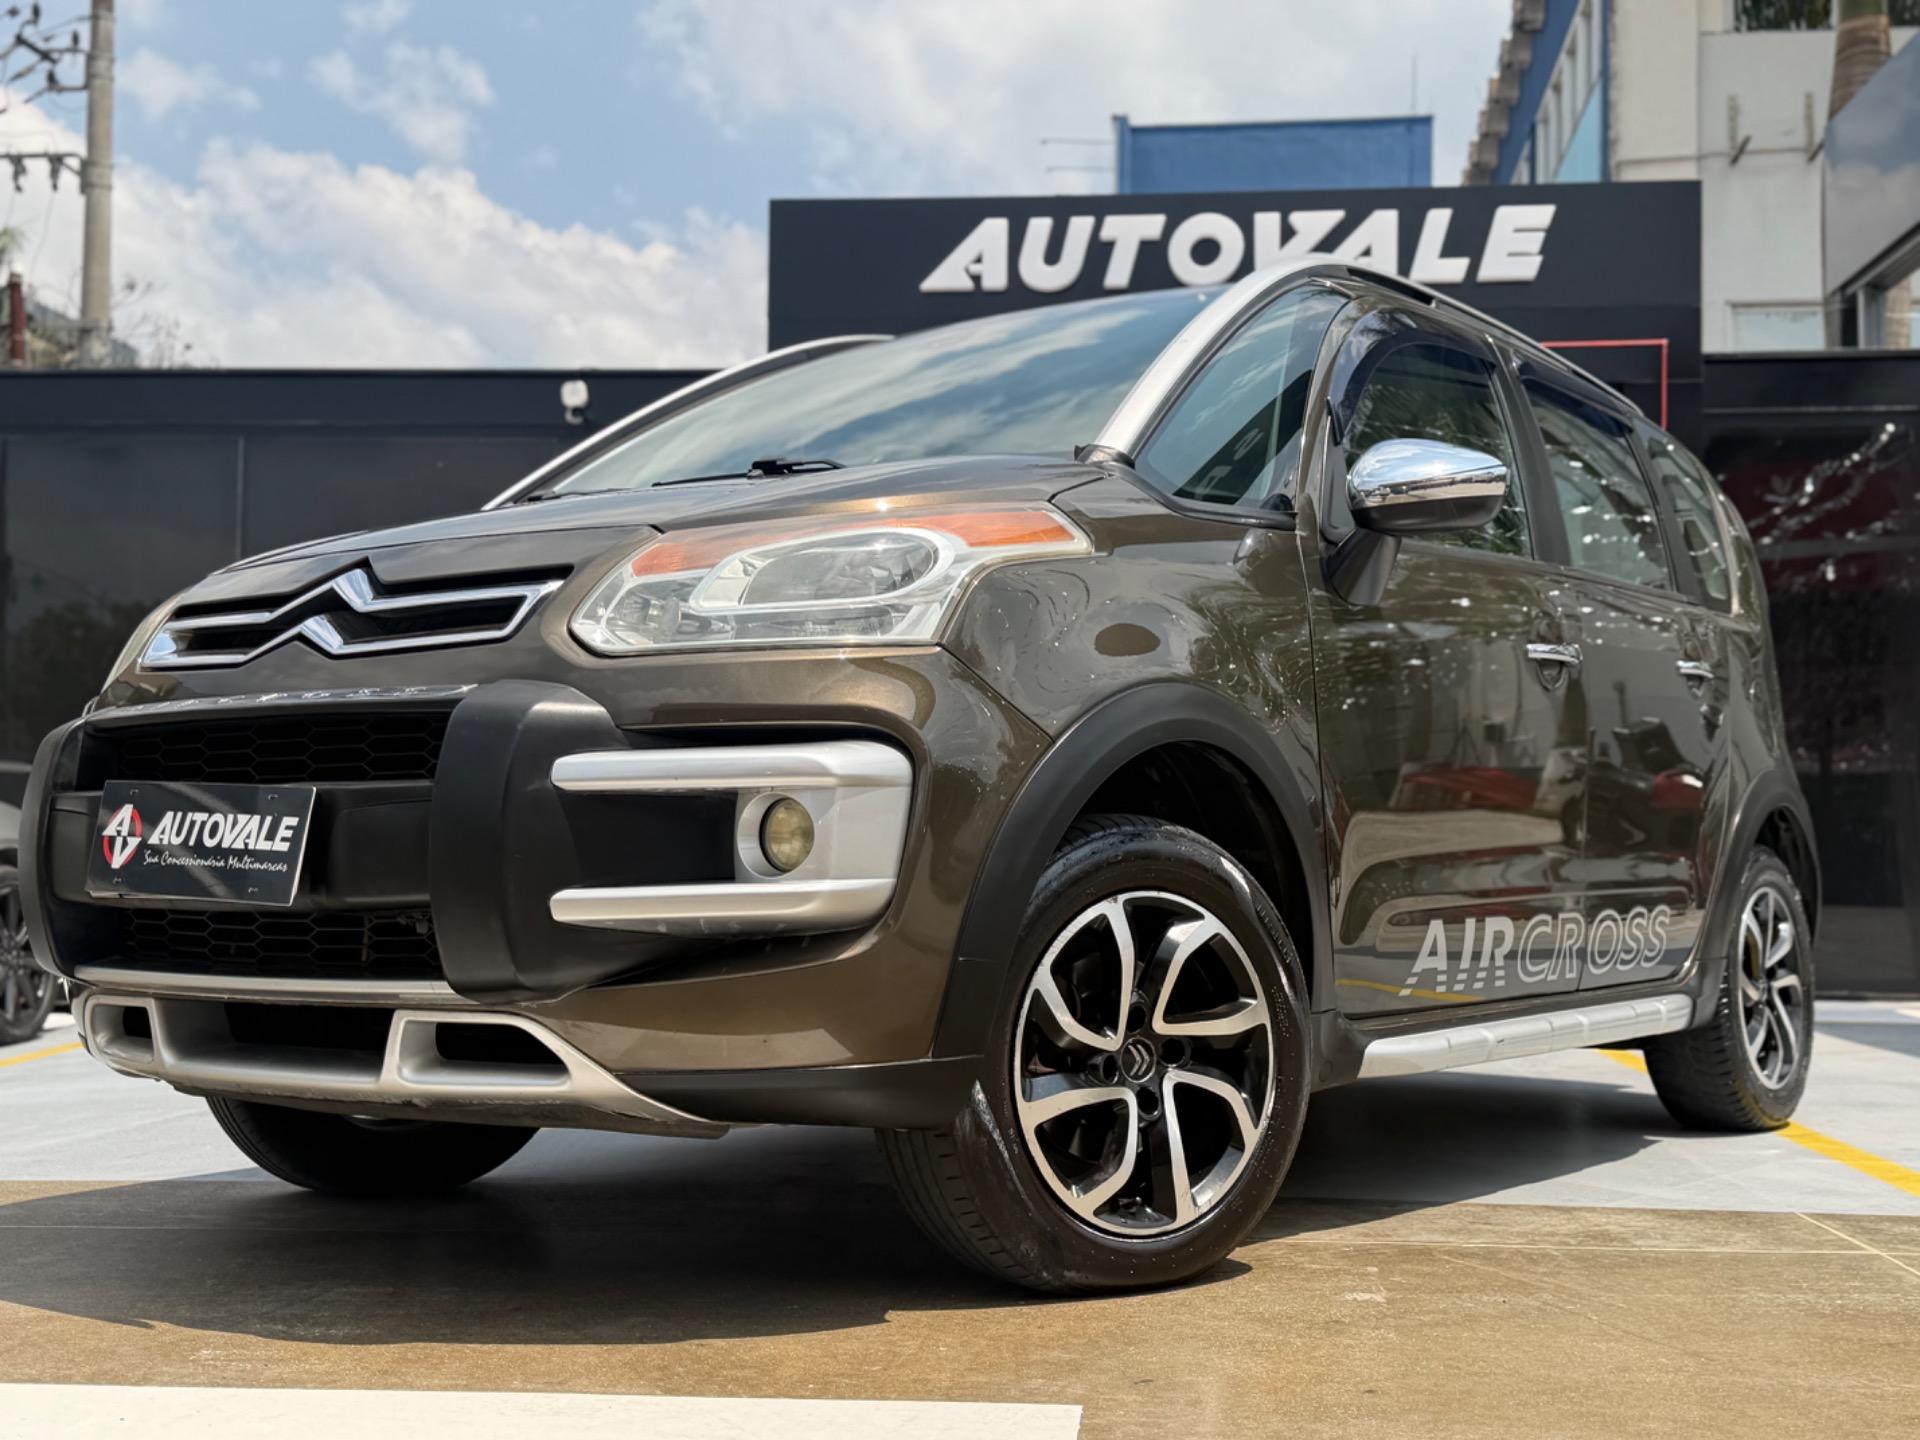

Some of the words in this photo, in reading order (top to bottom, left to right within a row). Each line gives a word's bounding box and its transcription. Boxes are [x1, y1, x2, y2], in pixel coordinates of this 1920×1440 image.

[919, 205, 1556, 292] AUTOVALE
[143, 849, 160, 865] Sua
[227, 855, 288, 872] Multimarcas
[148, 811, 299, 851] AUTOVALE
[1399, 904, 1671, 996] AIRCROSS
